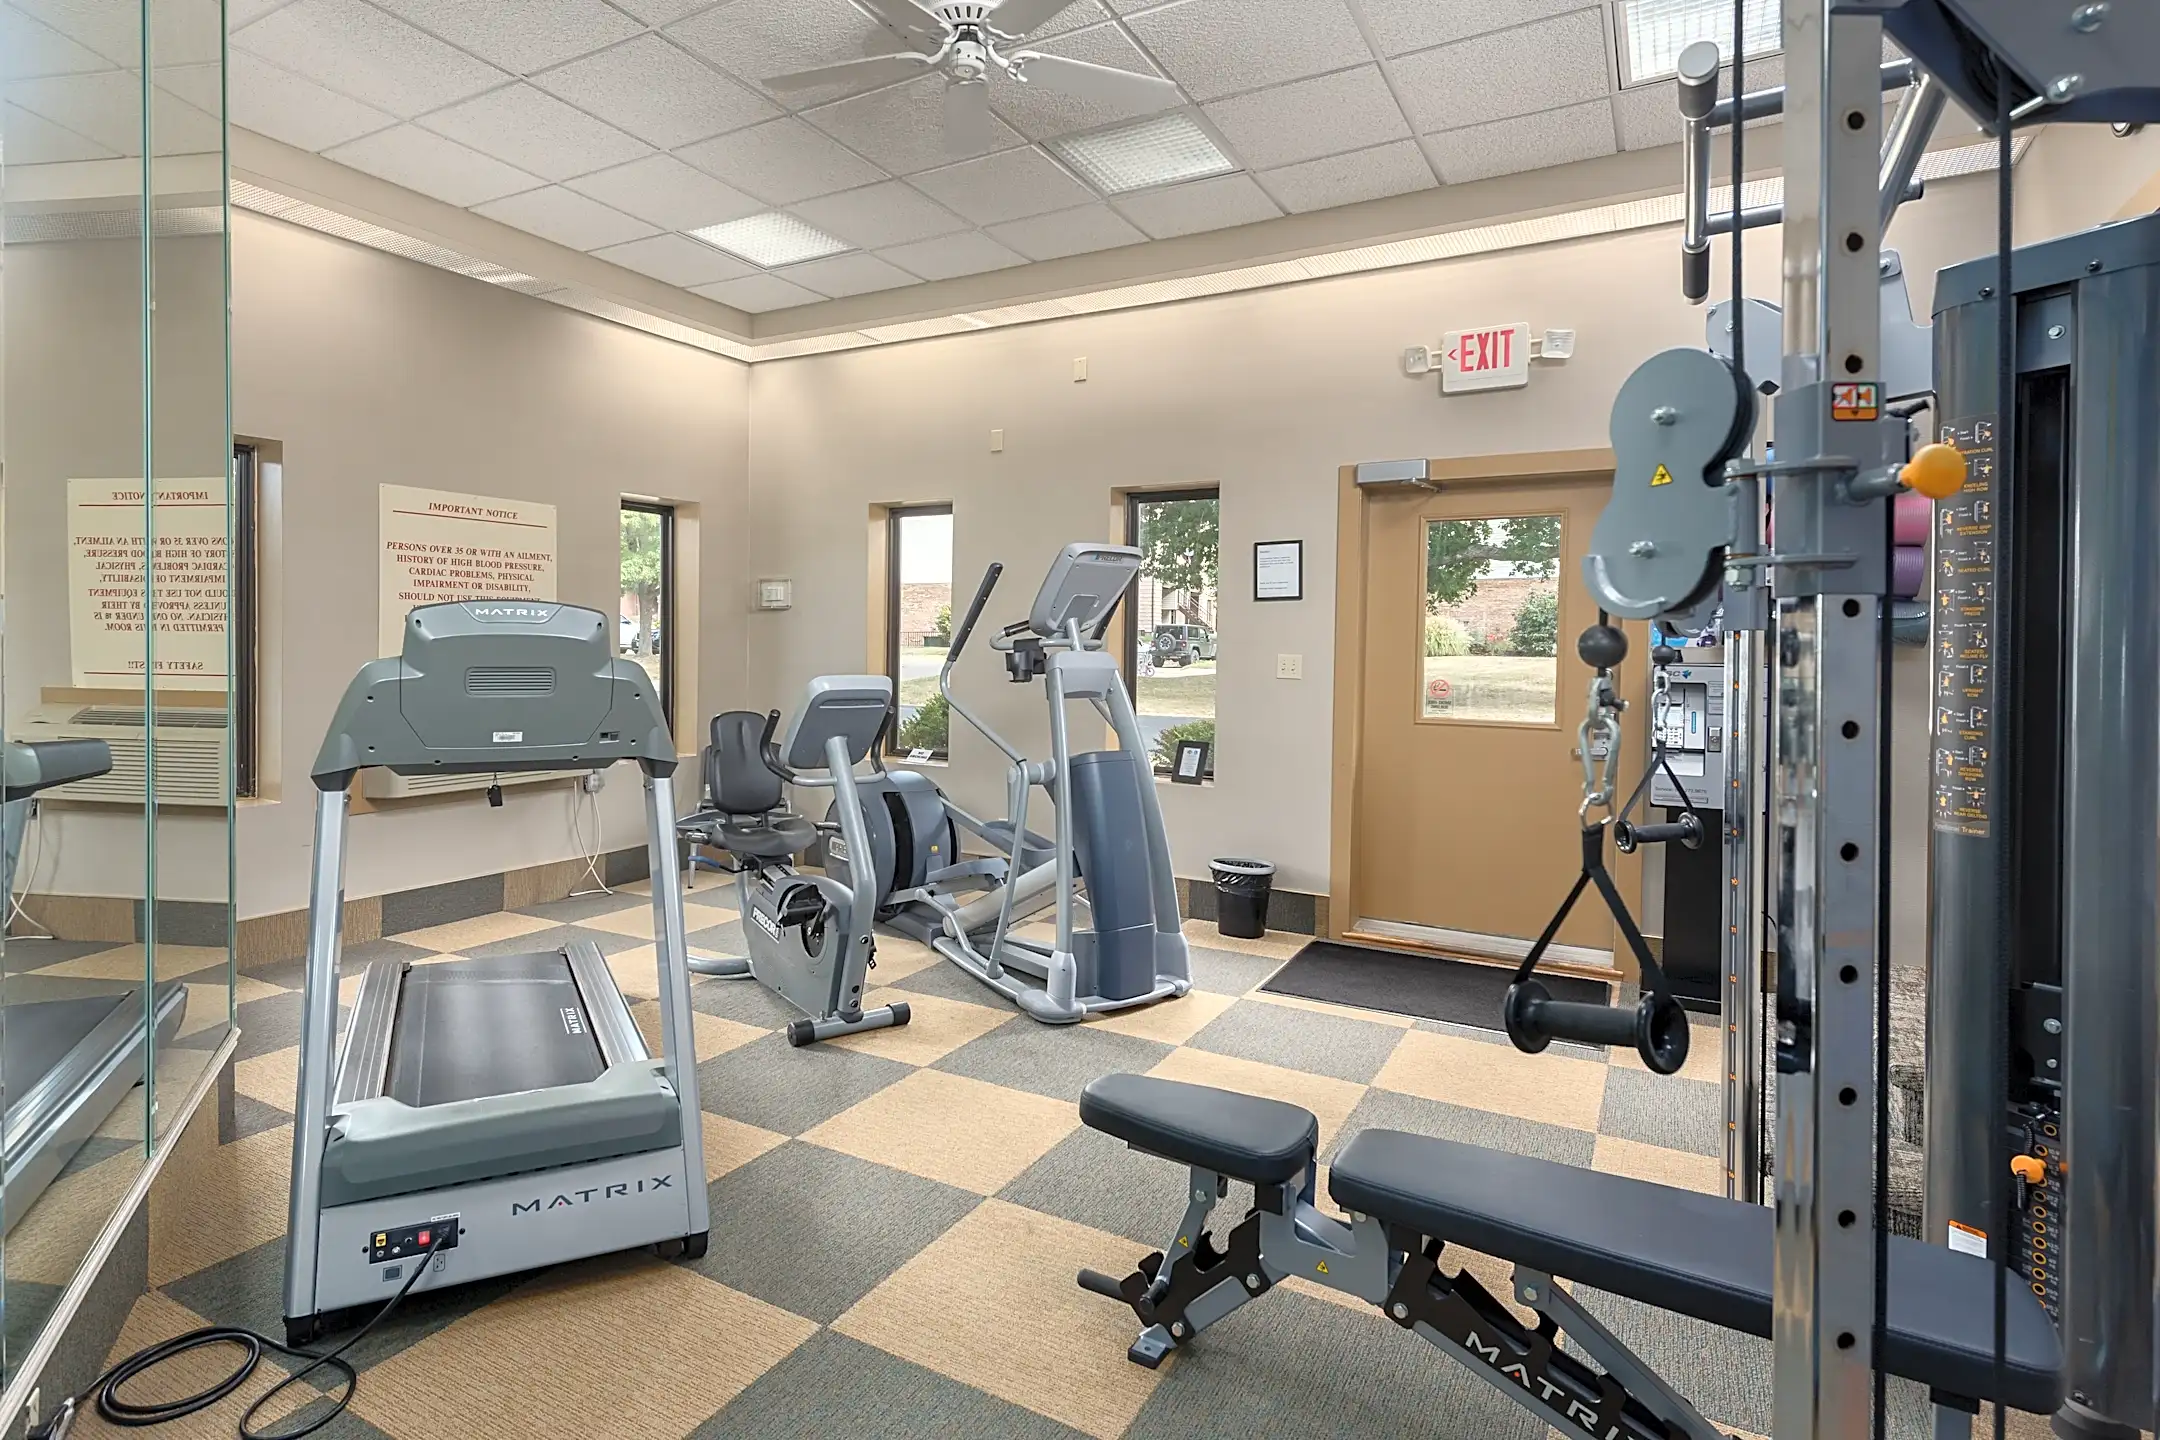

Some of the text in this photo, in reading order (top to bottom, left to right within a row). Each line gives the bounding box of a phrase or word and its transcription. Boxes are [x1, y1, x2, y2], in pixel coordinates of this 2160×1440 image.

[1460, 329, 1514, 372] EXIT
[428, 502, 518, 520] IMPORTANT NOTICE
[386, 542, 426, 552] PERSONS
[430, 545, 452, 554] OVER
[466, 547, 477, 556] OR
[480, 549, 501, 558] WITH
[504, 551, 515, 559] AN
[517, 552, 553, 562] AILMENT,
[396, 554, 433, 564] HISTORY
[451, 558, 472, 567] HIGH
[475, 559, 502, 569] BLOOD
[504, 562, 545, 572] PRESSURE,
[408, 567, 534, 581] CARDIAC PROBLEMS, PHYSICAL
[413, 579, 469, 589] IMPAIRMENT
[486, 583, 531, 593] DISABILITY,
[398, 592, 435, 601] SHOULD
[476, 608, 548, 617] MATRIX
[1961, 826, 1985, 834] Trainer
[752, 906, 776, 936] PRECOR
[565, 1007, 582, 1034] MATRIX
[512, 1175, 672, 1216] MATRIX
[1466, 1331, 1636, 1440] MATRI
